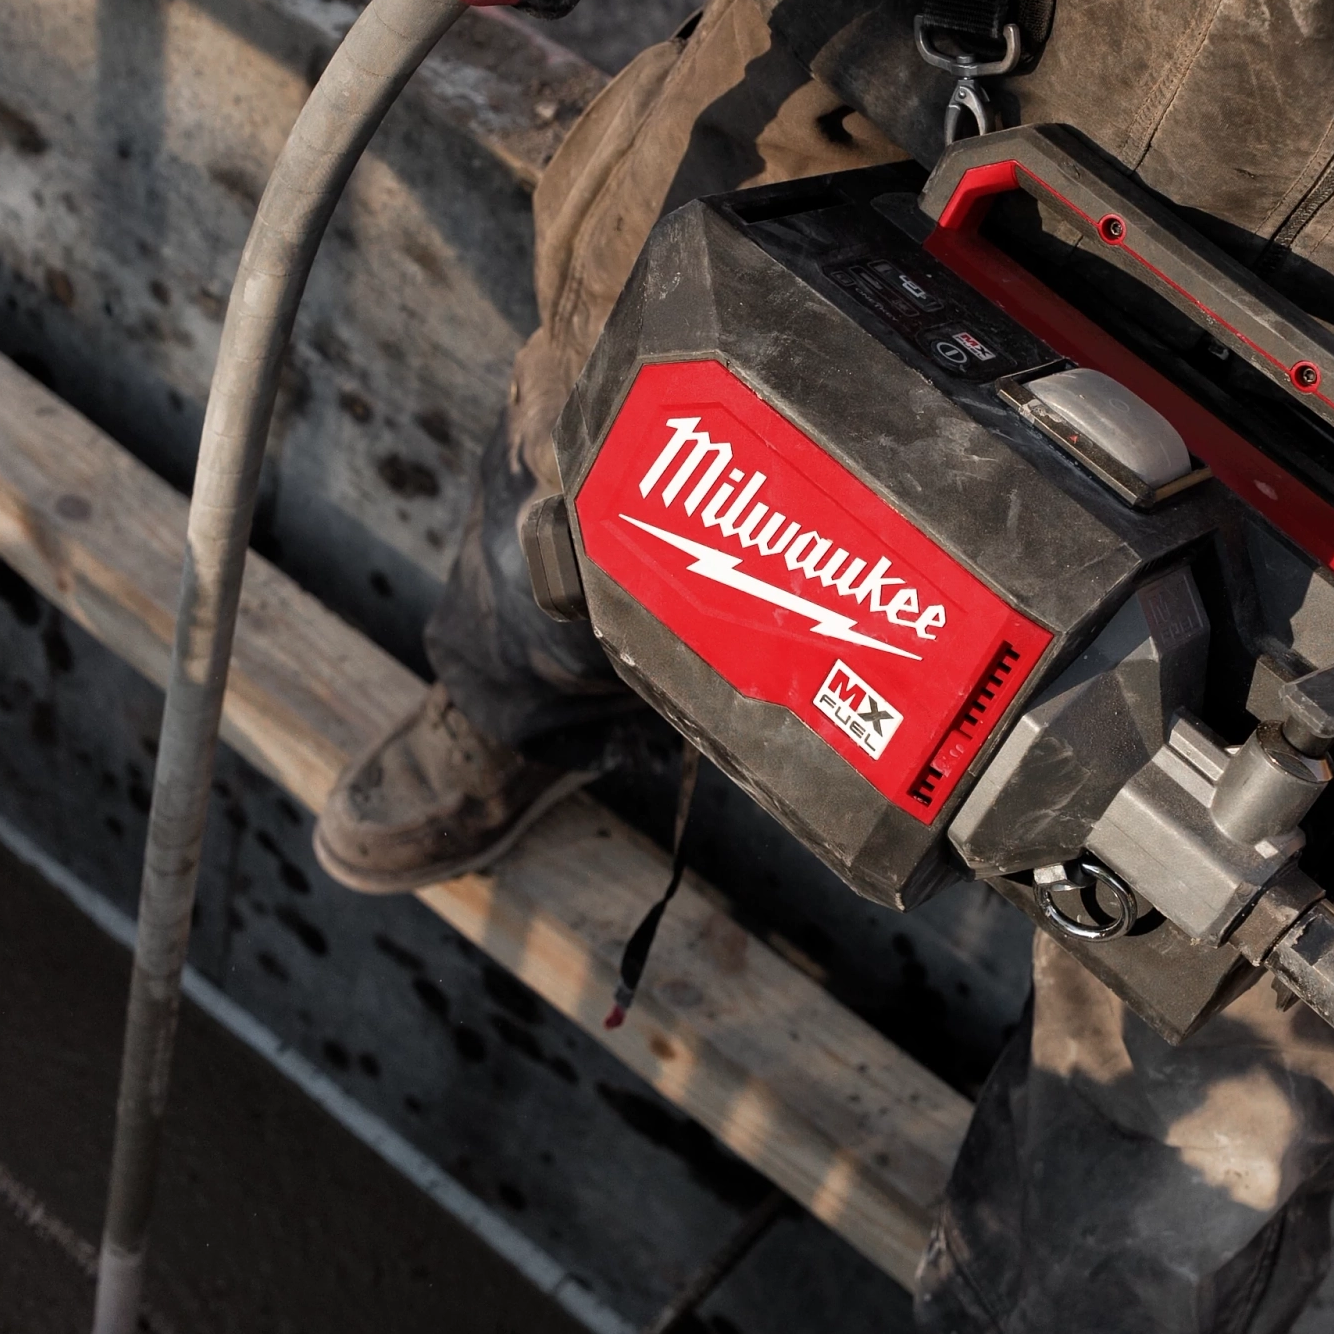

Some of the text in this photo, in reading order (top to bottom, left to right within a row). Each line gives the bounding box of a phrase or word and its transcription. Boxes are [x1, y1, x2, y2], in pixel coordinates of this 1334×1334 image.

[638, 416, 947, 641] Milwaukee
[819, 693, 876, 752] FUEL
[828, 668, 895, 738] MX
